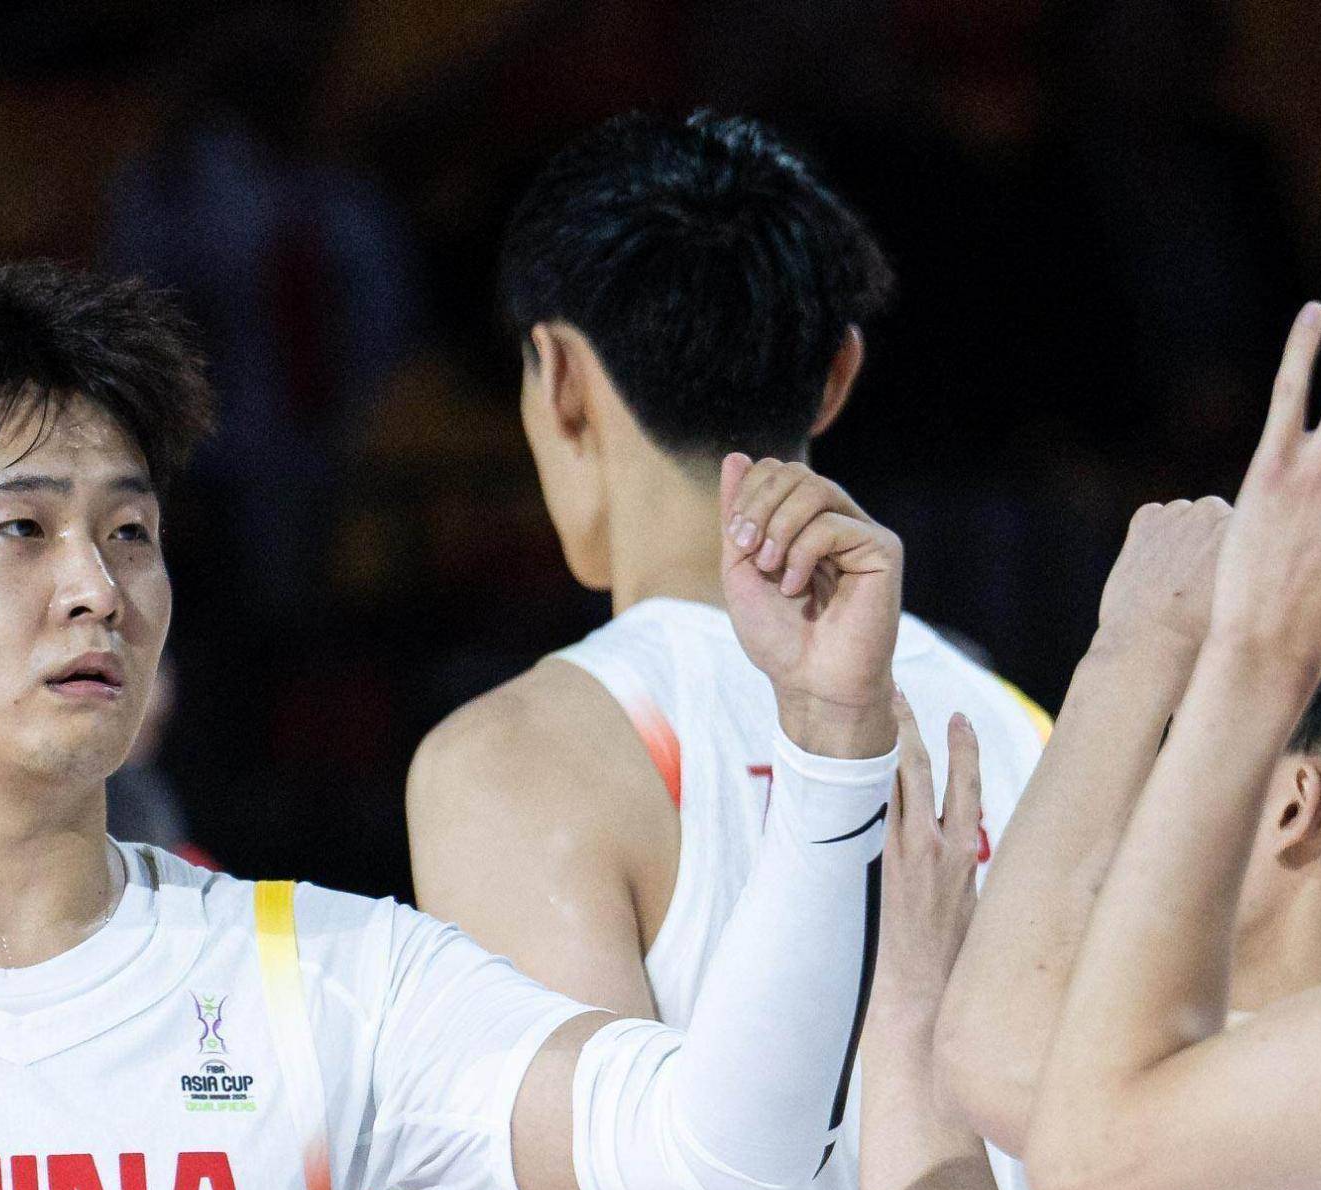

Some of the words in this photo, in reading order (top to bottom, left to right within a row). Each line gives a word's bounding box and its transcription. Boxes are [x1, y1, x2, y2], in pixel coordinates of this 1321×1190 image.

[206, 1065, 225, 1073] FIBA
[181, 1075, 218, 1091] ASIA
[221, 1075, 254, 1092] CUP
